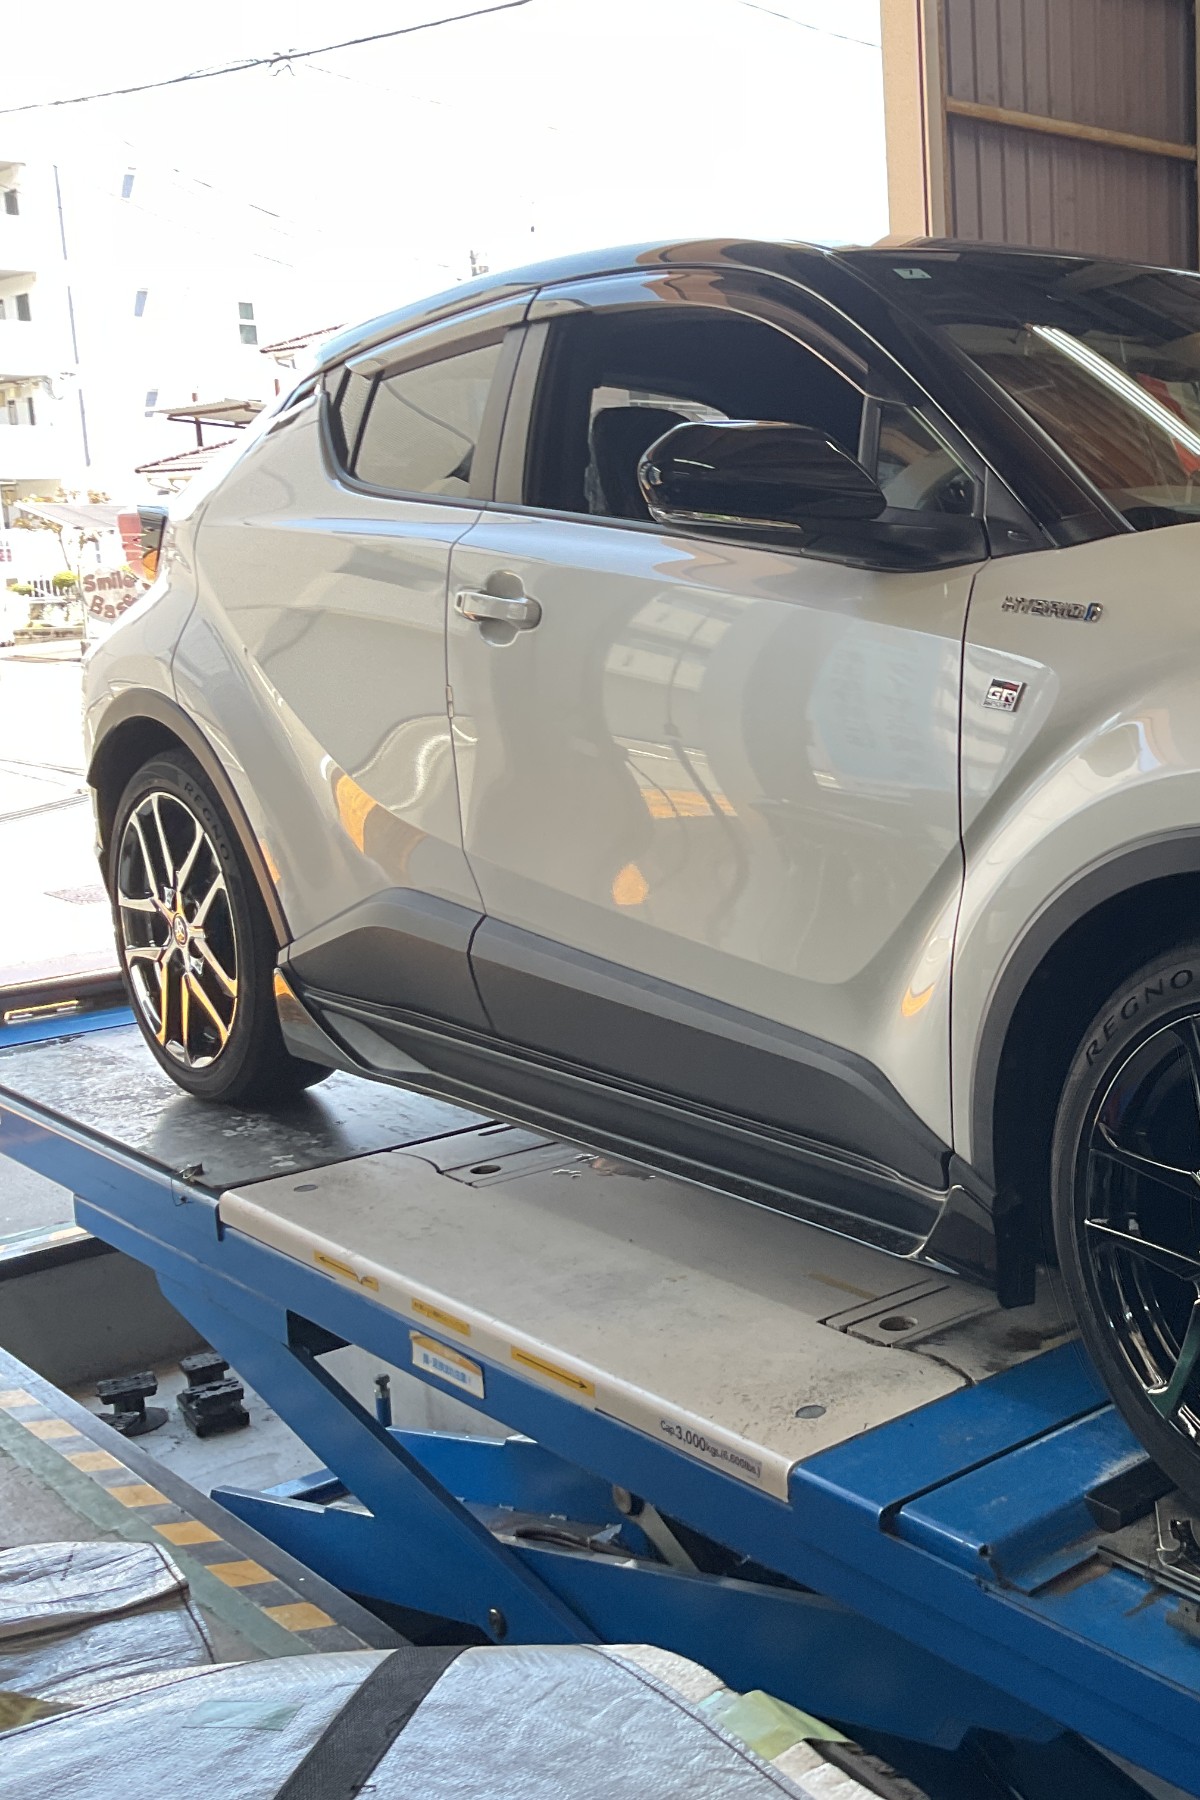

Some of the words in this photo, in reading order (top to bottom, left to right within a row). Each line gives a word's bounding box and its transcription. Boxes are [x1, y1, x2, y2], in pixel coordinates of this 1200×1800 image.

[83, 571, 135, 592] Smile
[1001, 596, 1086, 620] HYBRID
[988, 687, 1017, 703] GR
[184, 782, 229, 860] REGNO
[1085, 969, 1194, 1066] REGNO
